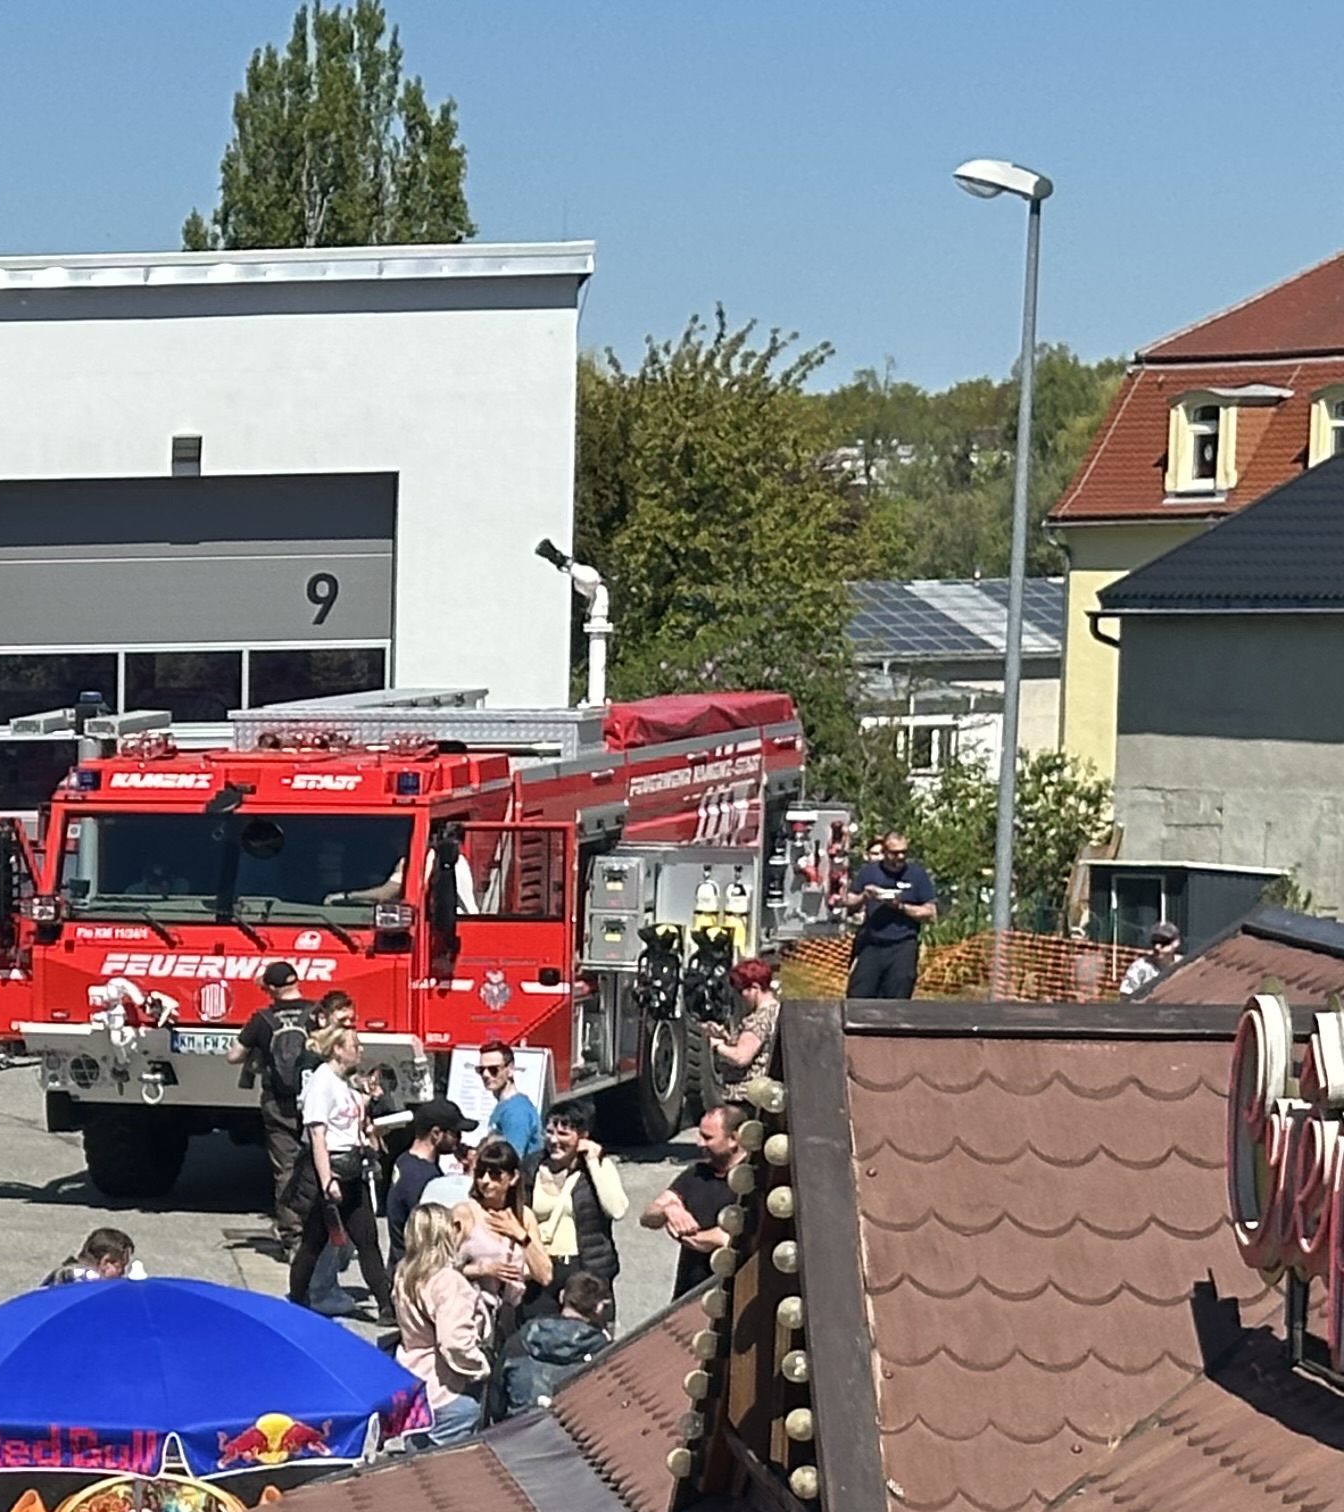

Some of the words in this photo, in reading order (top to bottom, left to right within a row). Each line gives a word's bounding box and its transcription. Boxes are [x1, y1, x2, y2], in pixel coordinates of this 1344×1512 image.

[304, 572, 339, 626] 9
[110, 773, 213, 788] KAMENZ
[101, 953, 336, 981] FEUERWHR
[180, 1036, 195, 1049] KM
[204, 1036, 219, 1049] FW
[69, 1427, 157, 1473] Bull
